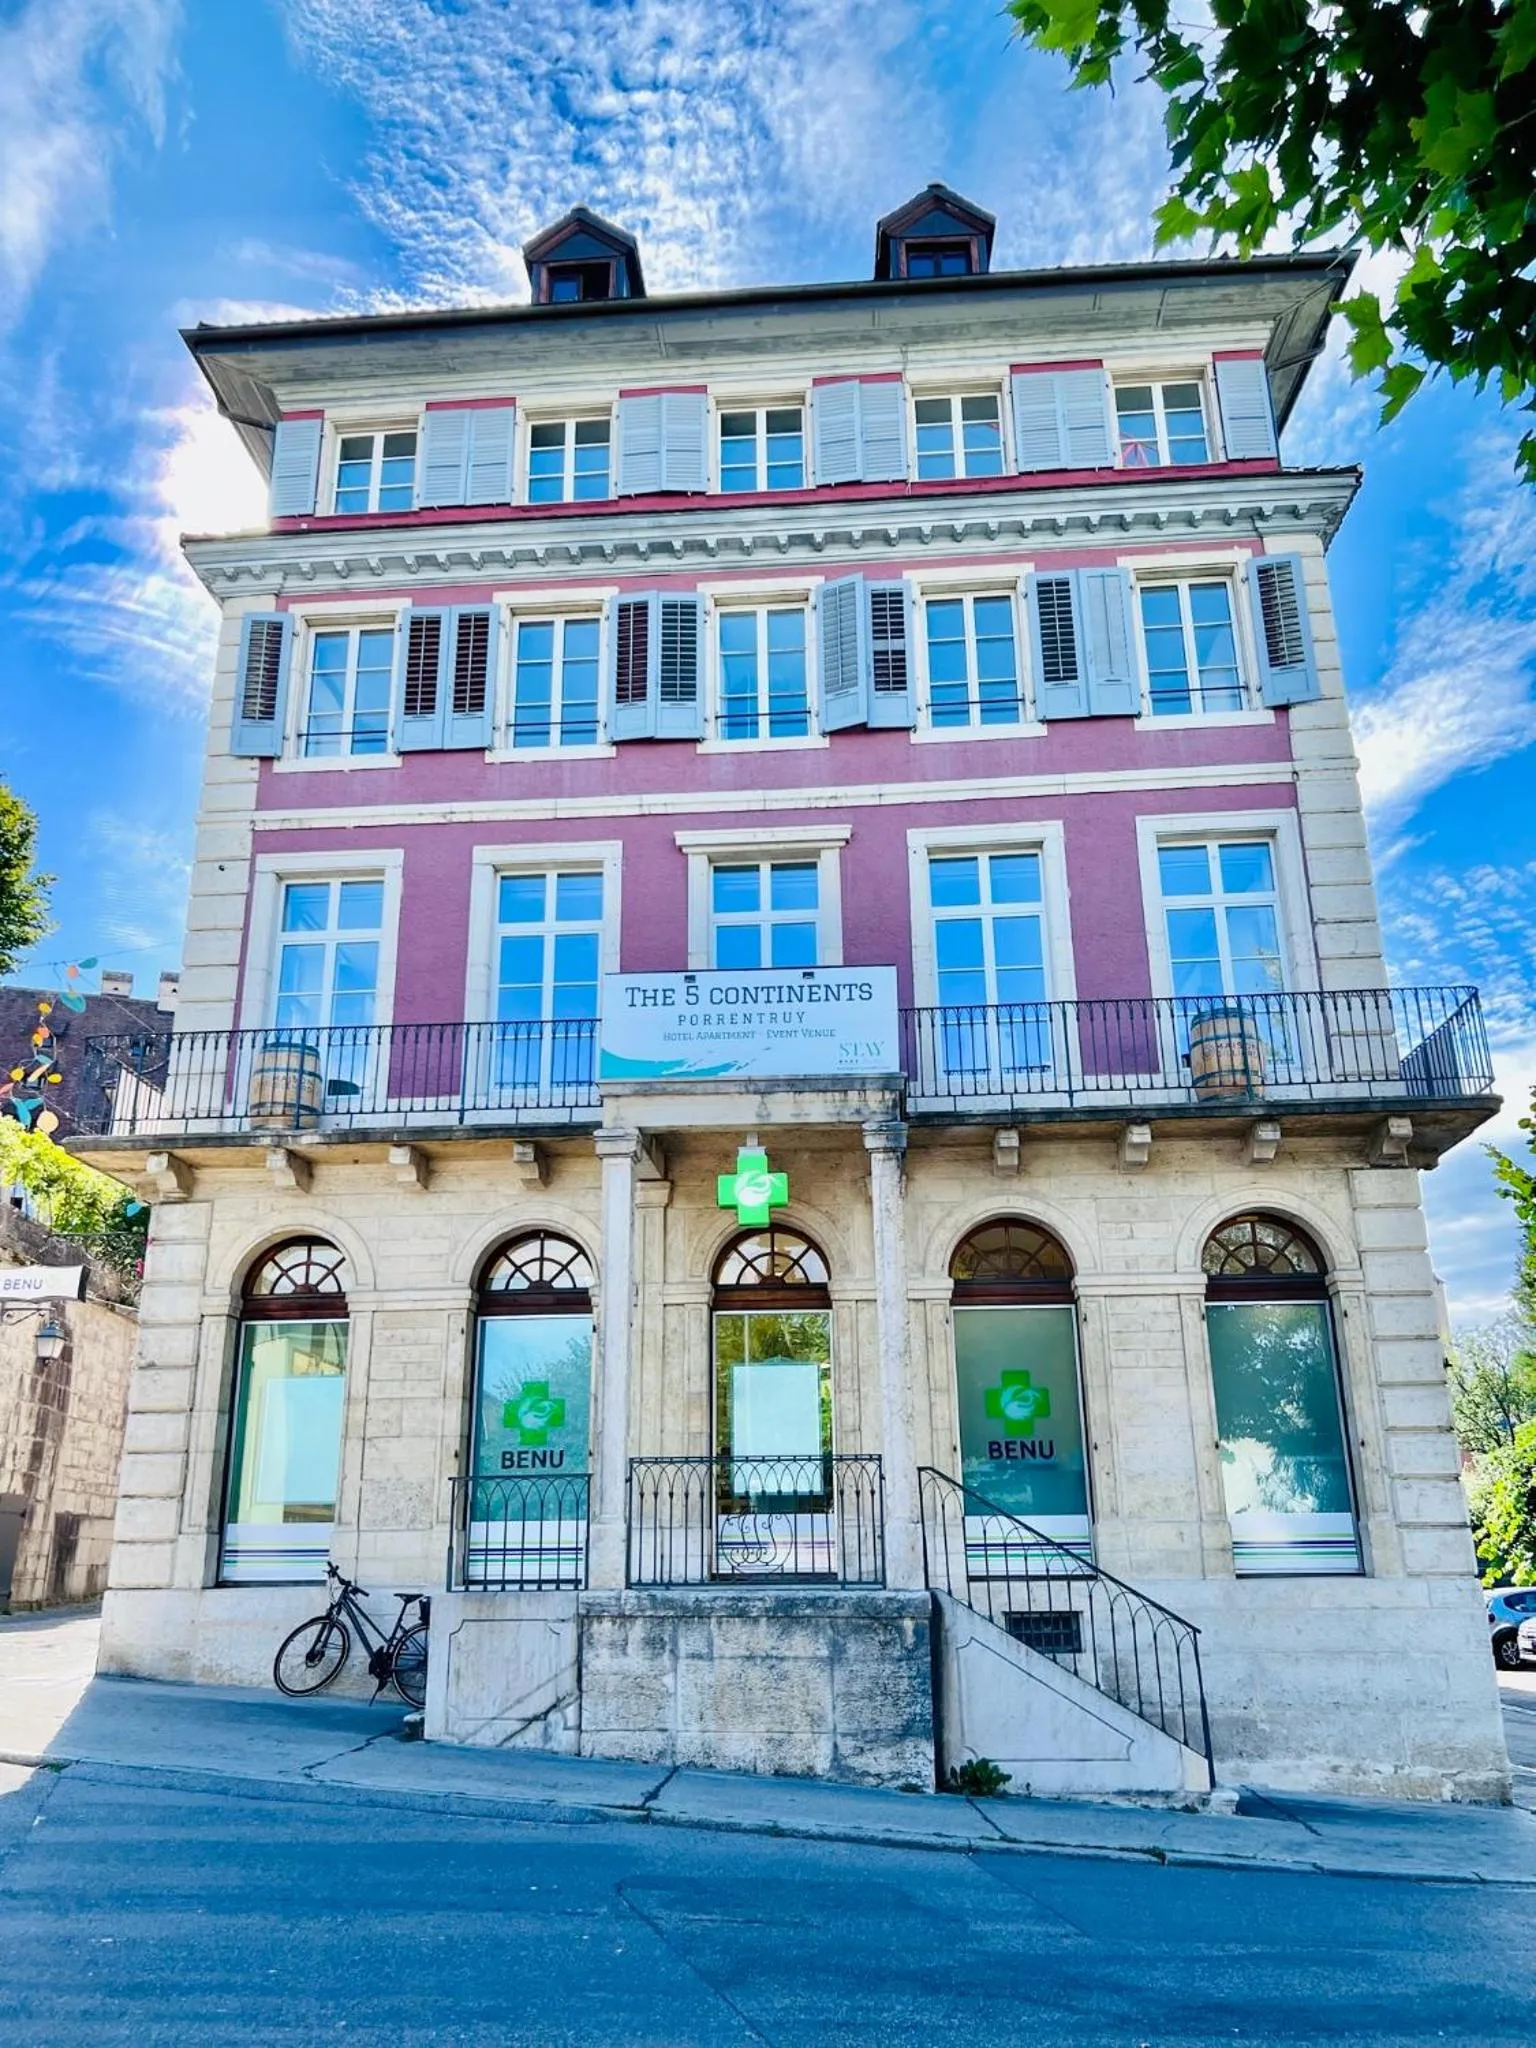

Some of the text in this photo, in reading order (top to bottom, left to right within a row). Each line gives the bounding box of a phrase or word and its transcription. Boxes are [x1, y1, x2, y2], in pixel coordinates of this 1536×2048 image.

[625, 982, 873, 1007] THE 5 CONTINENTS
[678, 1011, 806, 1027] PORRENTRUY
[664, 1031, 693, 1041] HOTEL
[766, 1029, 798, 1039] EVENT
[800, 1028, 837, 1038] VENUE
[3, 1278, 43, 1291] BENU
[501, 1449, 564, 1469] BENU
[988, 1440, 1055, 1460] BENU
